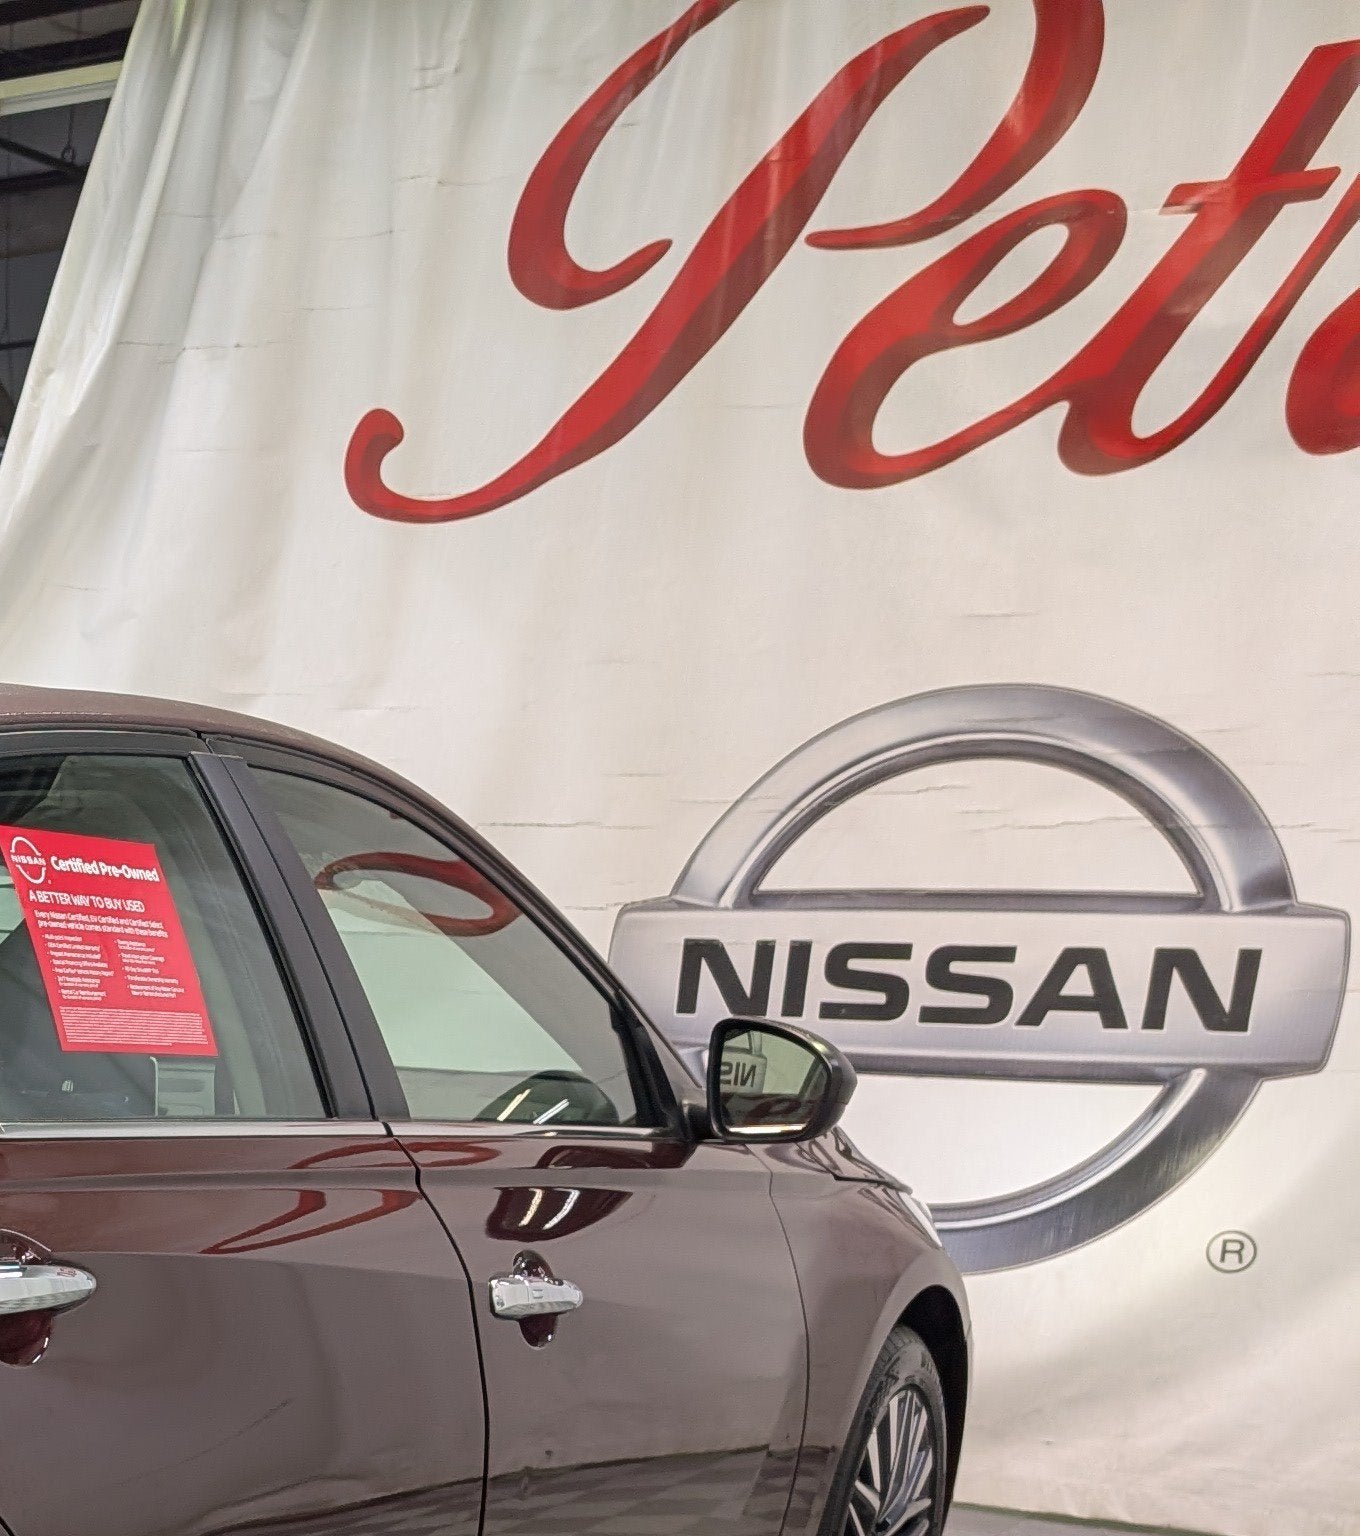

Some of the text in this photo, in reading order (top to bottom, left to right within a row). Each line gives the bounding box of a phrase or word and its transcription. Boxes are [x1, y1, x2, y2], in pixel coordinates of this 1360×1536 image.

[11, 854, 47, 867] NISSAN
[50, 856, 160, 882] Certified Pre-Owned
[29, 889, 146, 913] A BETTER WAY TO BUY USED
[675, 936, 1263, 1033] NISSAN
